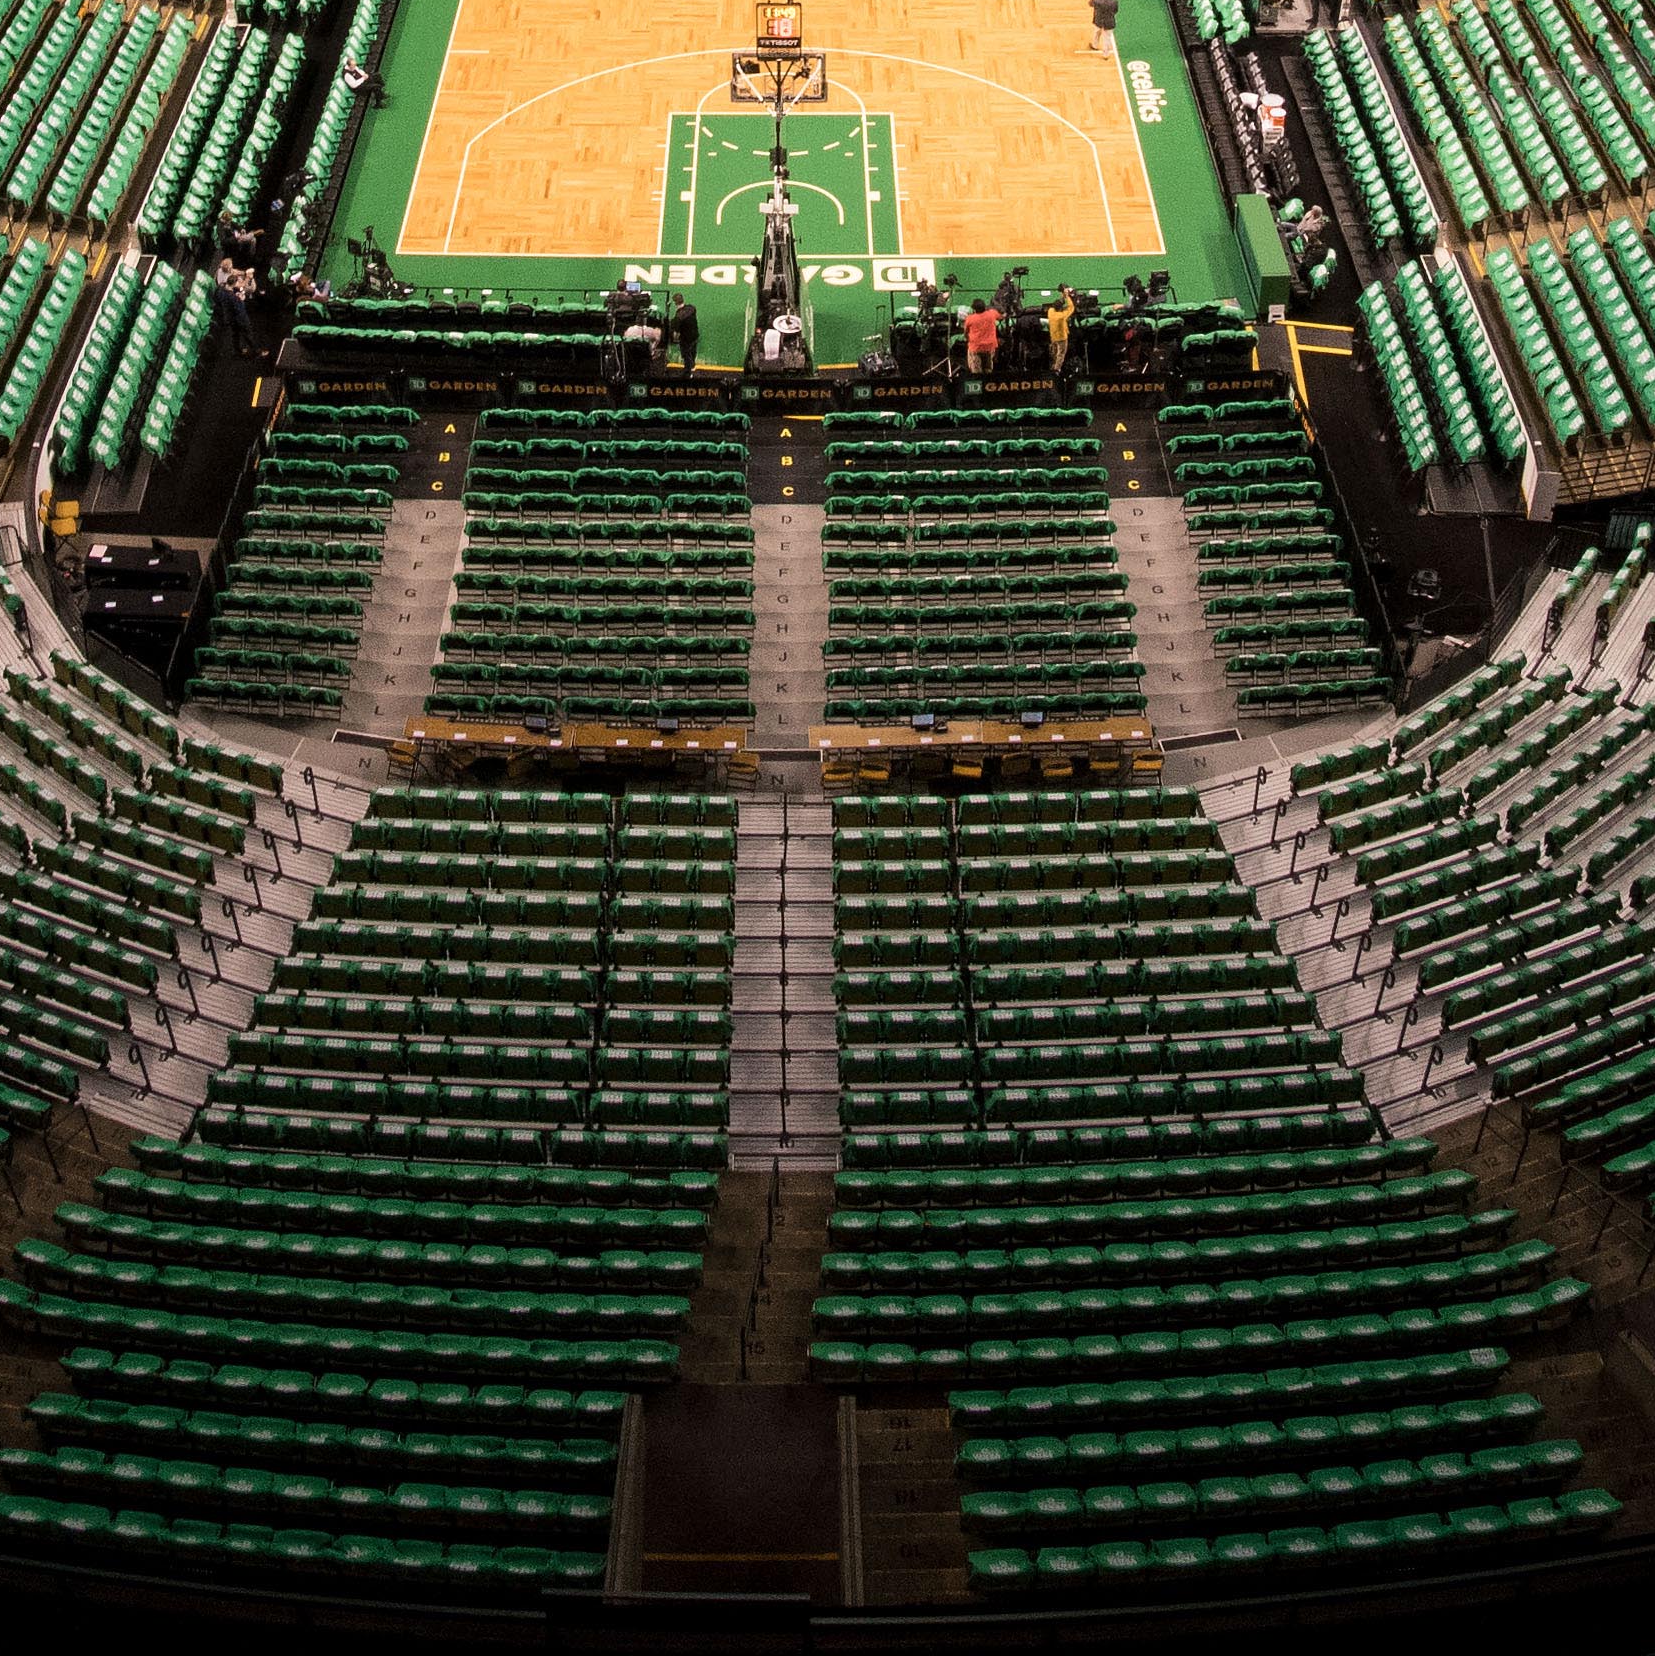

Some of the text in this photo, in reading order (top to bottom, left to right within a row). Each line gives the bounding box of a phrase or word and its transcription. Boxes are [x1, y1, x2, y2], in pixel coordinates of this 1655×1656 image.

[771, 39, 799, 47] TISSOT
[1126, 60, 1168, 123] @celtics
[319, 381, 387, 393] GARDEN
[428, 380, 498, 392] GARDEN
[538, 383, 608, 395] GARDEN
[985, 380, 1054, 392] GARDEN
[1097, 382, 1165, 394] GARDEN
[1207, 378, 1274, 391] GARDEN
[650, 386, 720, 397] GARDEN
[762, 389, 832, 399] GARDEN
[874, 385, 944, 397] GARDEN
[445, 424, 456, 434] A
[1115, 422, 1127, 432] A
[780, 428, 792, 438] A
[439, 452, 450, 462] B
[1122, 451, 1135, 460] B
[781, 456, 793, 466] B
[431, 481, 443, 491] C
[1128, 480, 1140, 489] C
[782, 486, 794, 496] C
[425, 510, 436, 520] D
[1132, 508, 1144, 517] D
[781, 514, 792, 524] D
[420, 535, 430, 544] E
[1140, 533, 1151, 542] E
[780, 542, 790, 551] E
[413, 561, 424, 570] F
[1146, 559, 1157, 568] F
[779, 568, 789, 577] F
[405, 589, 417, 598] G
[1152, 585, 1163, 594] G
[777, 594, 789, 604] G
[398, 613, 410, 623] H
[1157, 613, 1170, 623] H
[776, 624, 788, 634] H
[393, 647, 402, 656] J
[1166, 642, 1175, 652] J
[778, 652, 787, 662] J
[384, 674, 396, 685] K
[1171, 672, 1184, 682] K
[776, 683, 788, 693] K
[375, 705, 384, 716] L
[1179, 703, 1191, 714] L
[778, 714, 788, 724] L
[358, 758, 372, 769] N
[1193, 757, 1207, 767] N
[770, 775, 784, 786] N
